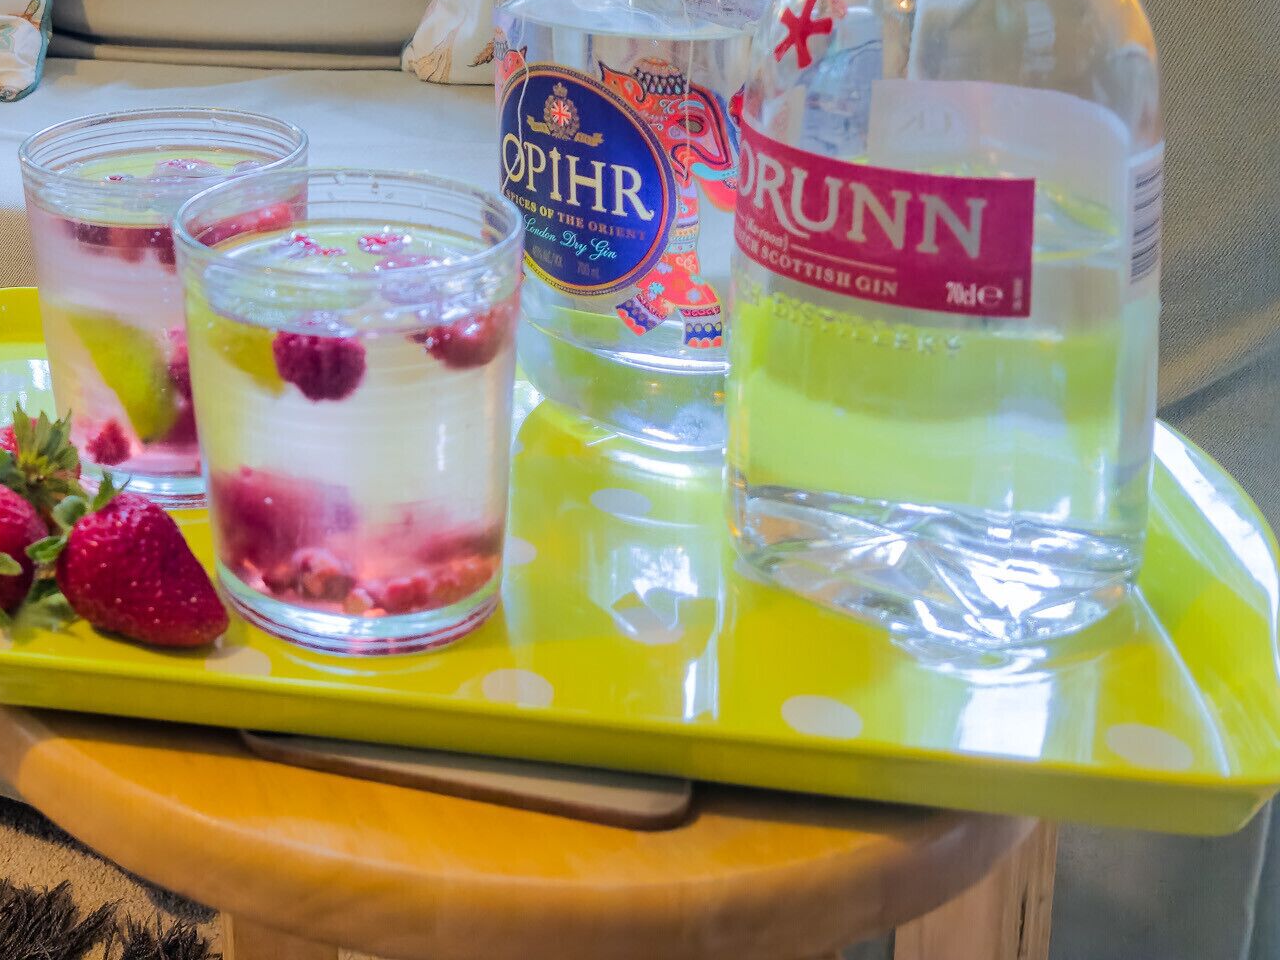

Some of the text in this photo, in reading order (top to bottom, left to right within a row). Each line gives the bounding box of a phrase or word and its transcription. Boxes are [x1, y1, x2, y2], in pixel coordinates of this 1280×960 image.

[523, 213, 557, 243] London
[559, 230, 587, 256] Dry
[589, 237, 618, 261] Gin
[539, 204, 555, 220] OF
[556, 210, 585, 230] THE
[761, 244, 899, 298] SCOTTISH GIN
